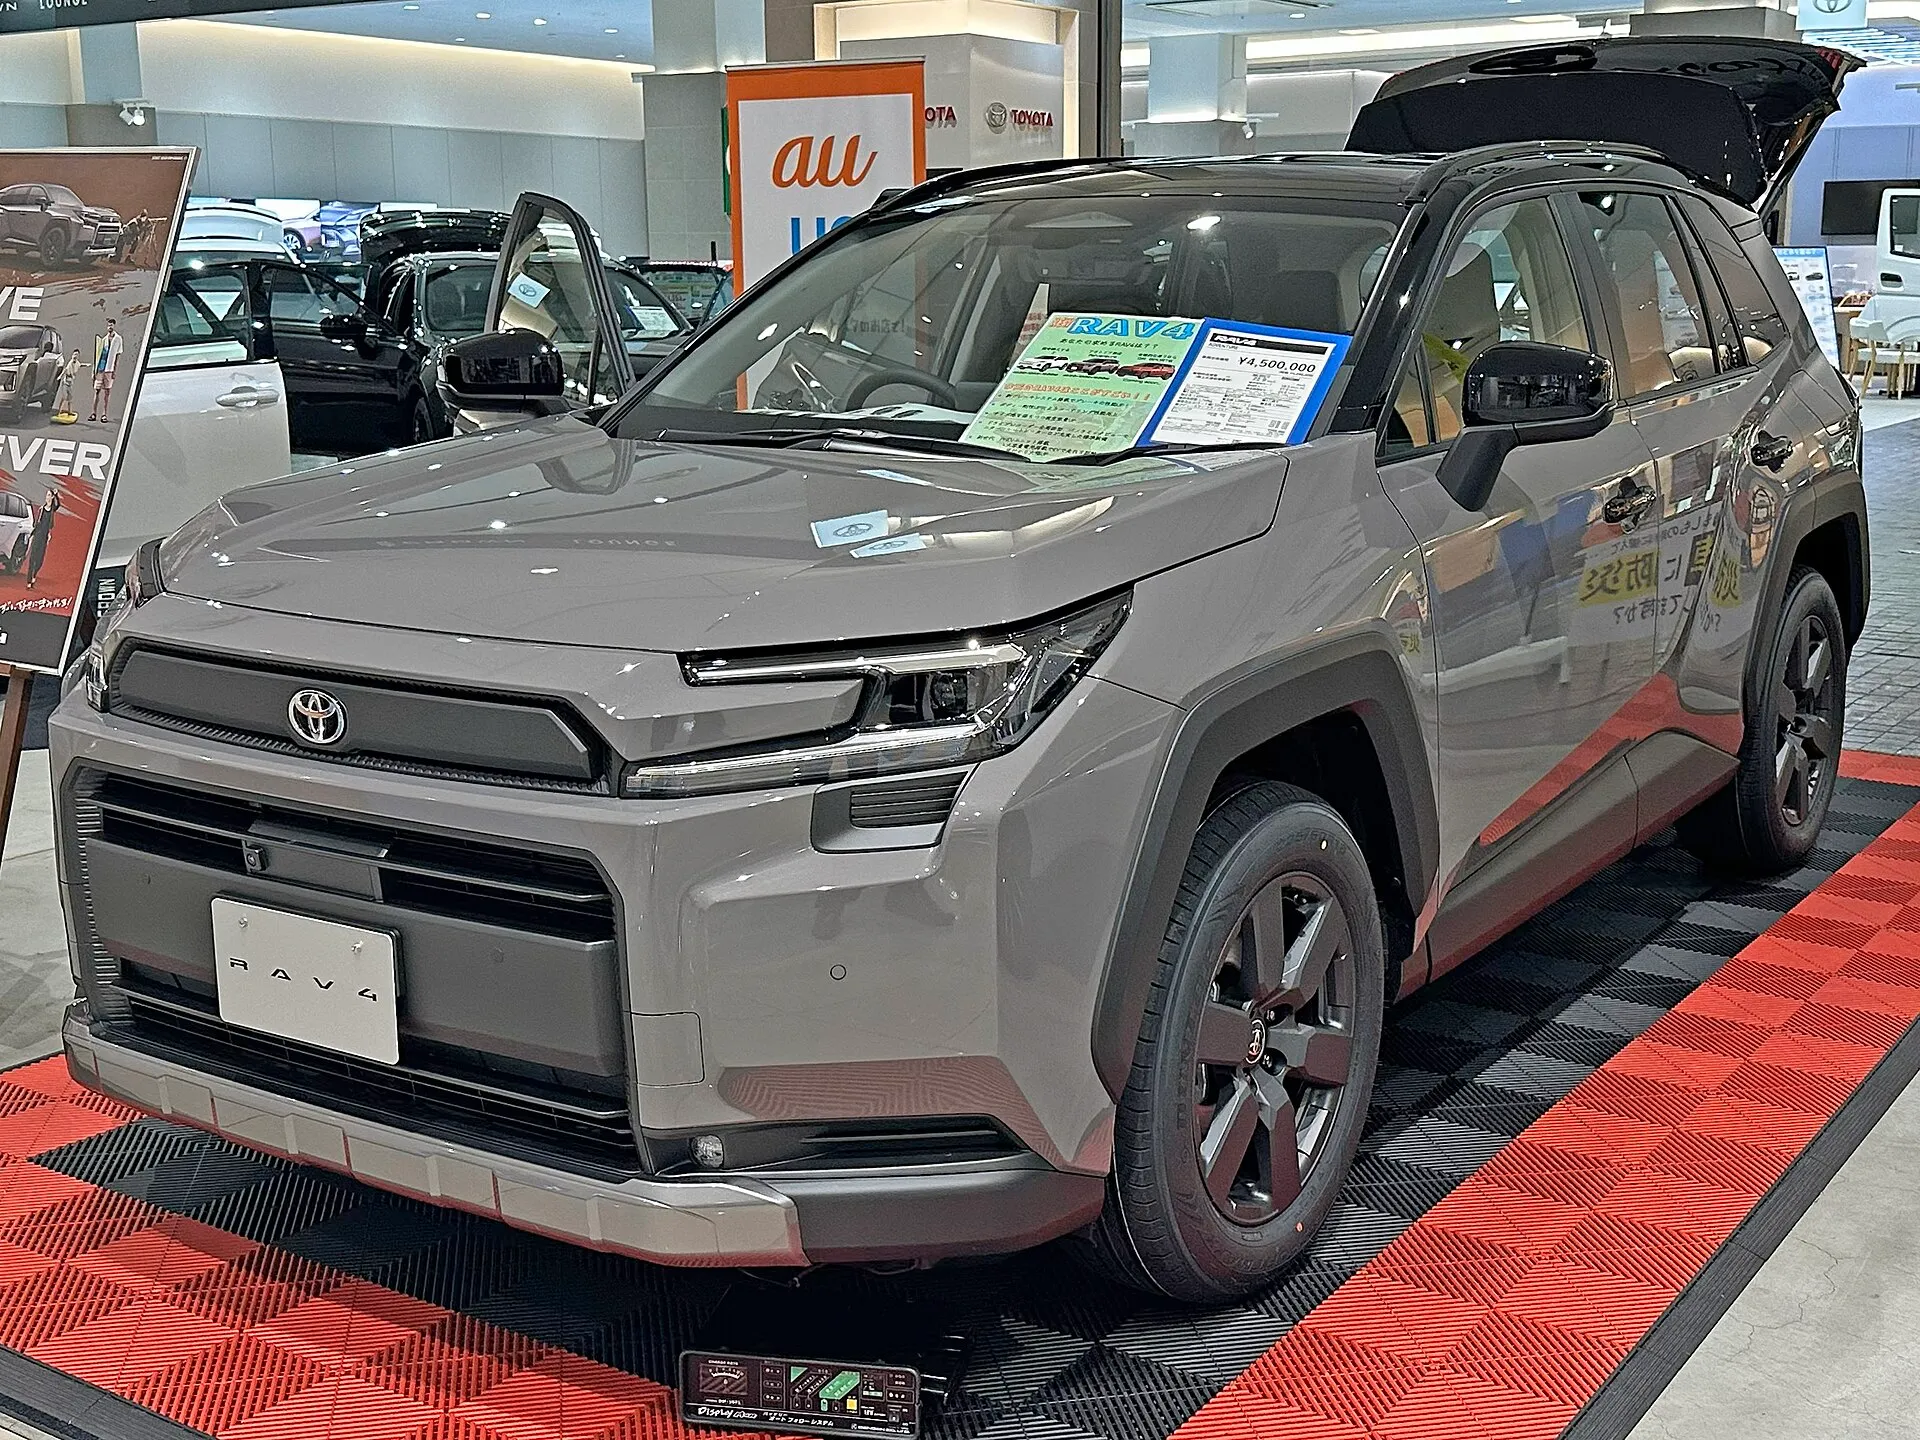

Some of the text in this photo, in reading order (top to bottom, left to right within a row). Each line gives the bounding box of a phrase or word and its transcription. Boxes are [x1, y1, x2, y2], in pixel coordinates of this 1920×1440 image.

[925, 106, 957, 122] OTA
[1011, 109, 1053, 126] TOYOTA
[772, 134, 878, 188] au
[1067, 316, 1197, 340] RAV4
[229, 957, 378, 1002] RAV4
